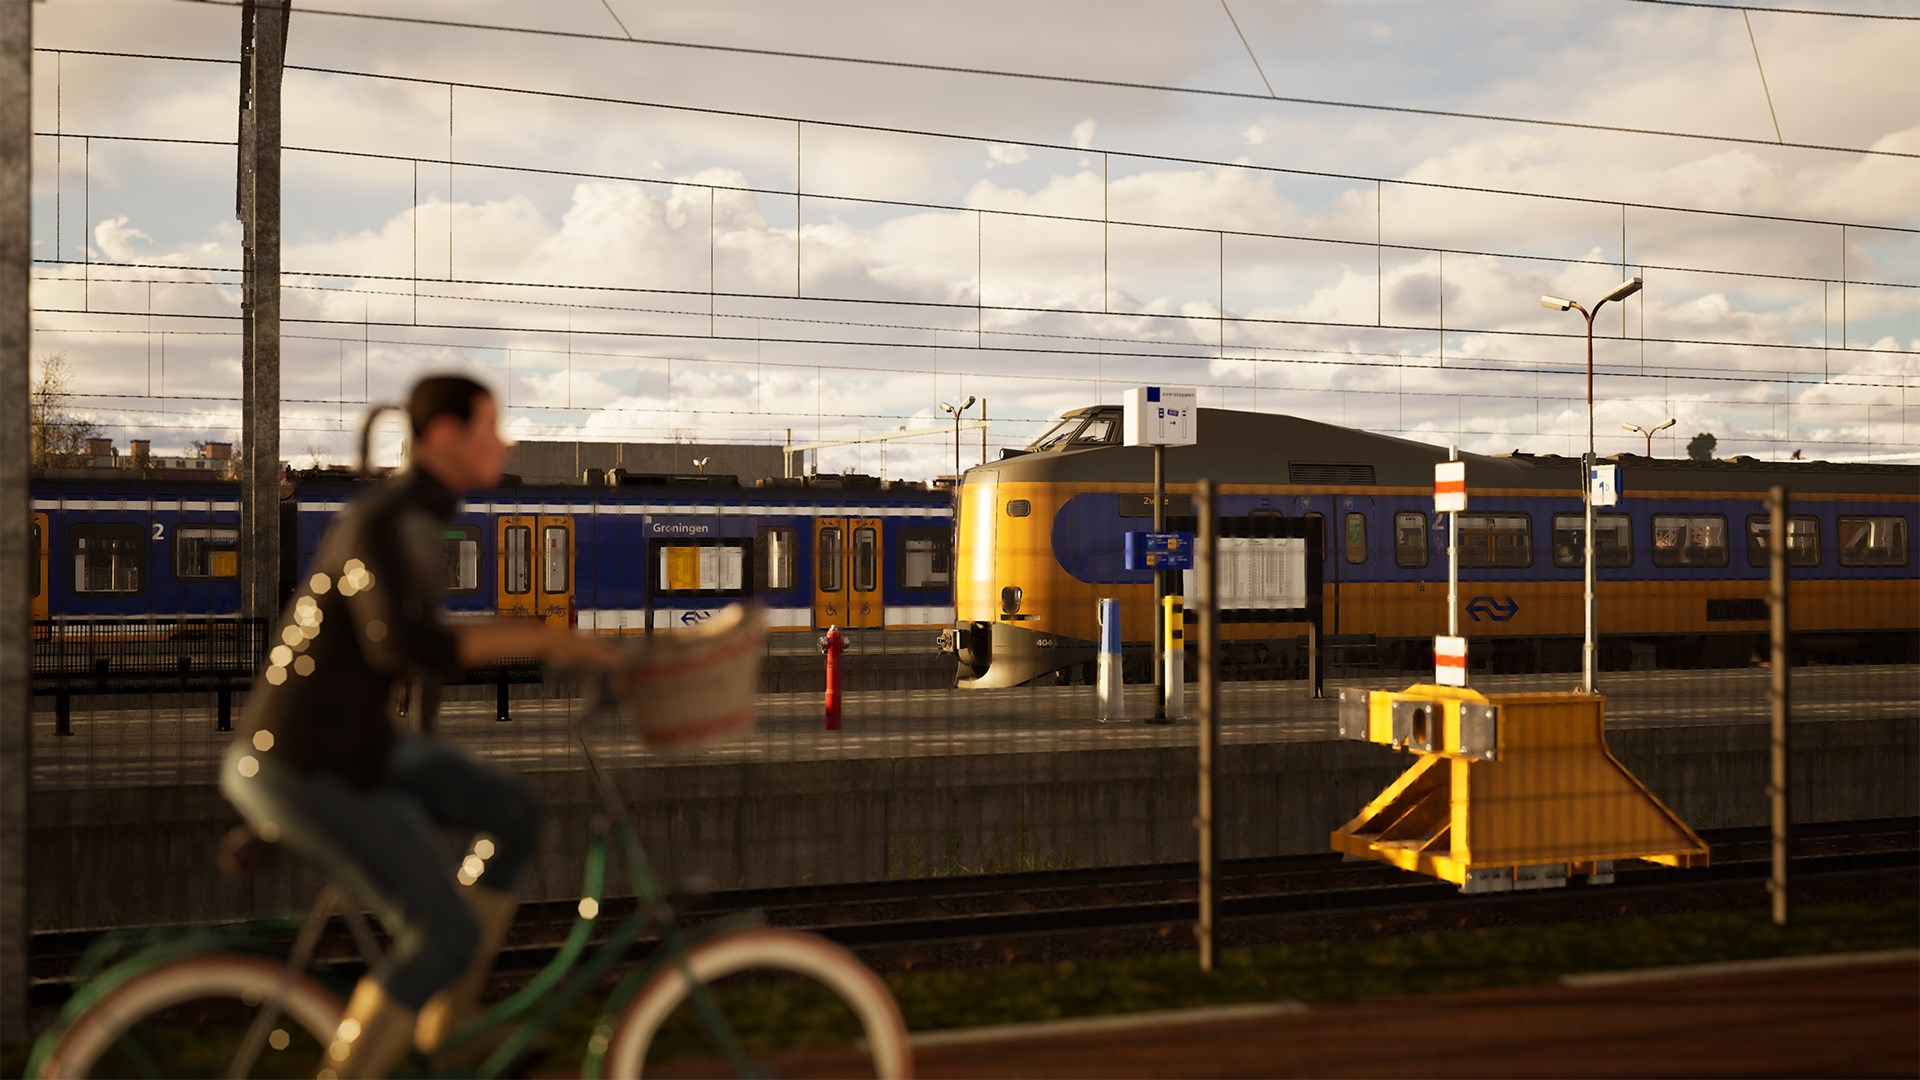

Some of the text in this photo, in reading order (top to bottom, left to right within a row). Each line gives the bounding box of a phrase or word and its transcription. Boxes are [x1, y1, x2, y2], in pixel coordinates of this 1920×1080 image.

[1143, 496, 1169, 506] Zwe
[152, 523, 165, 541] 2
[652, 522, 709, 535] Groningen
